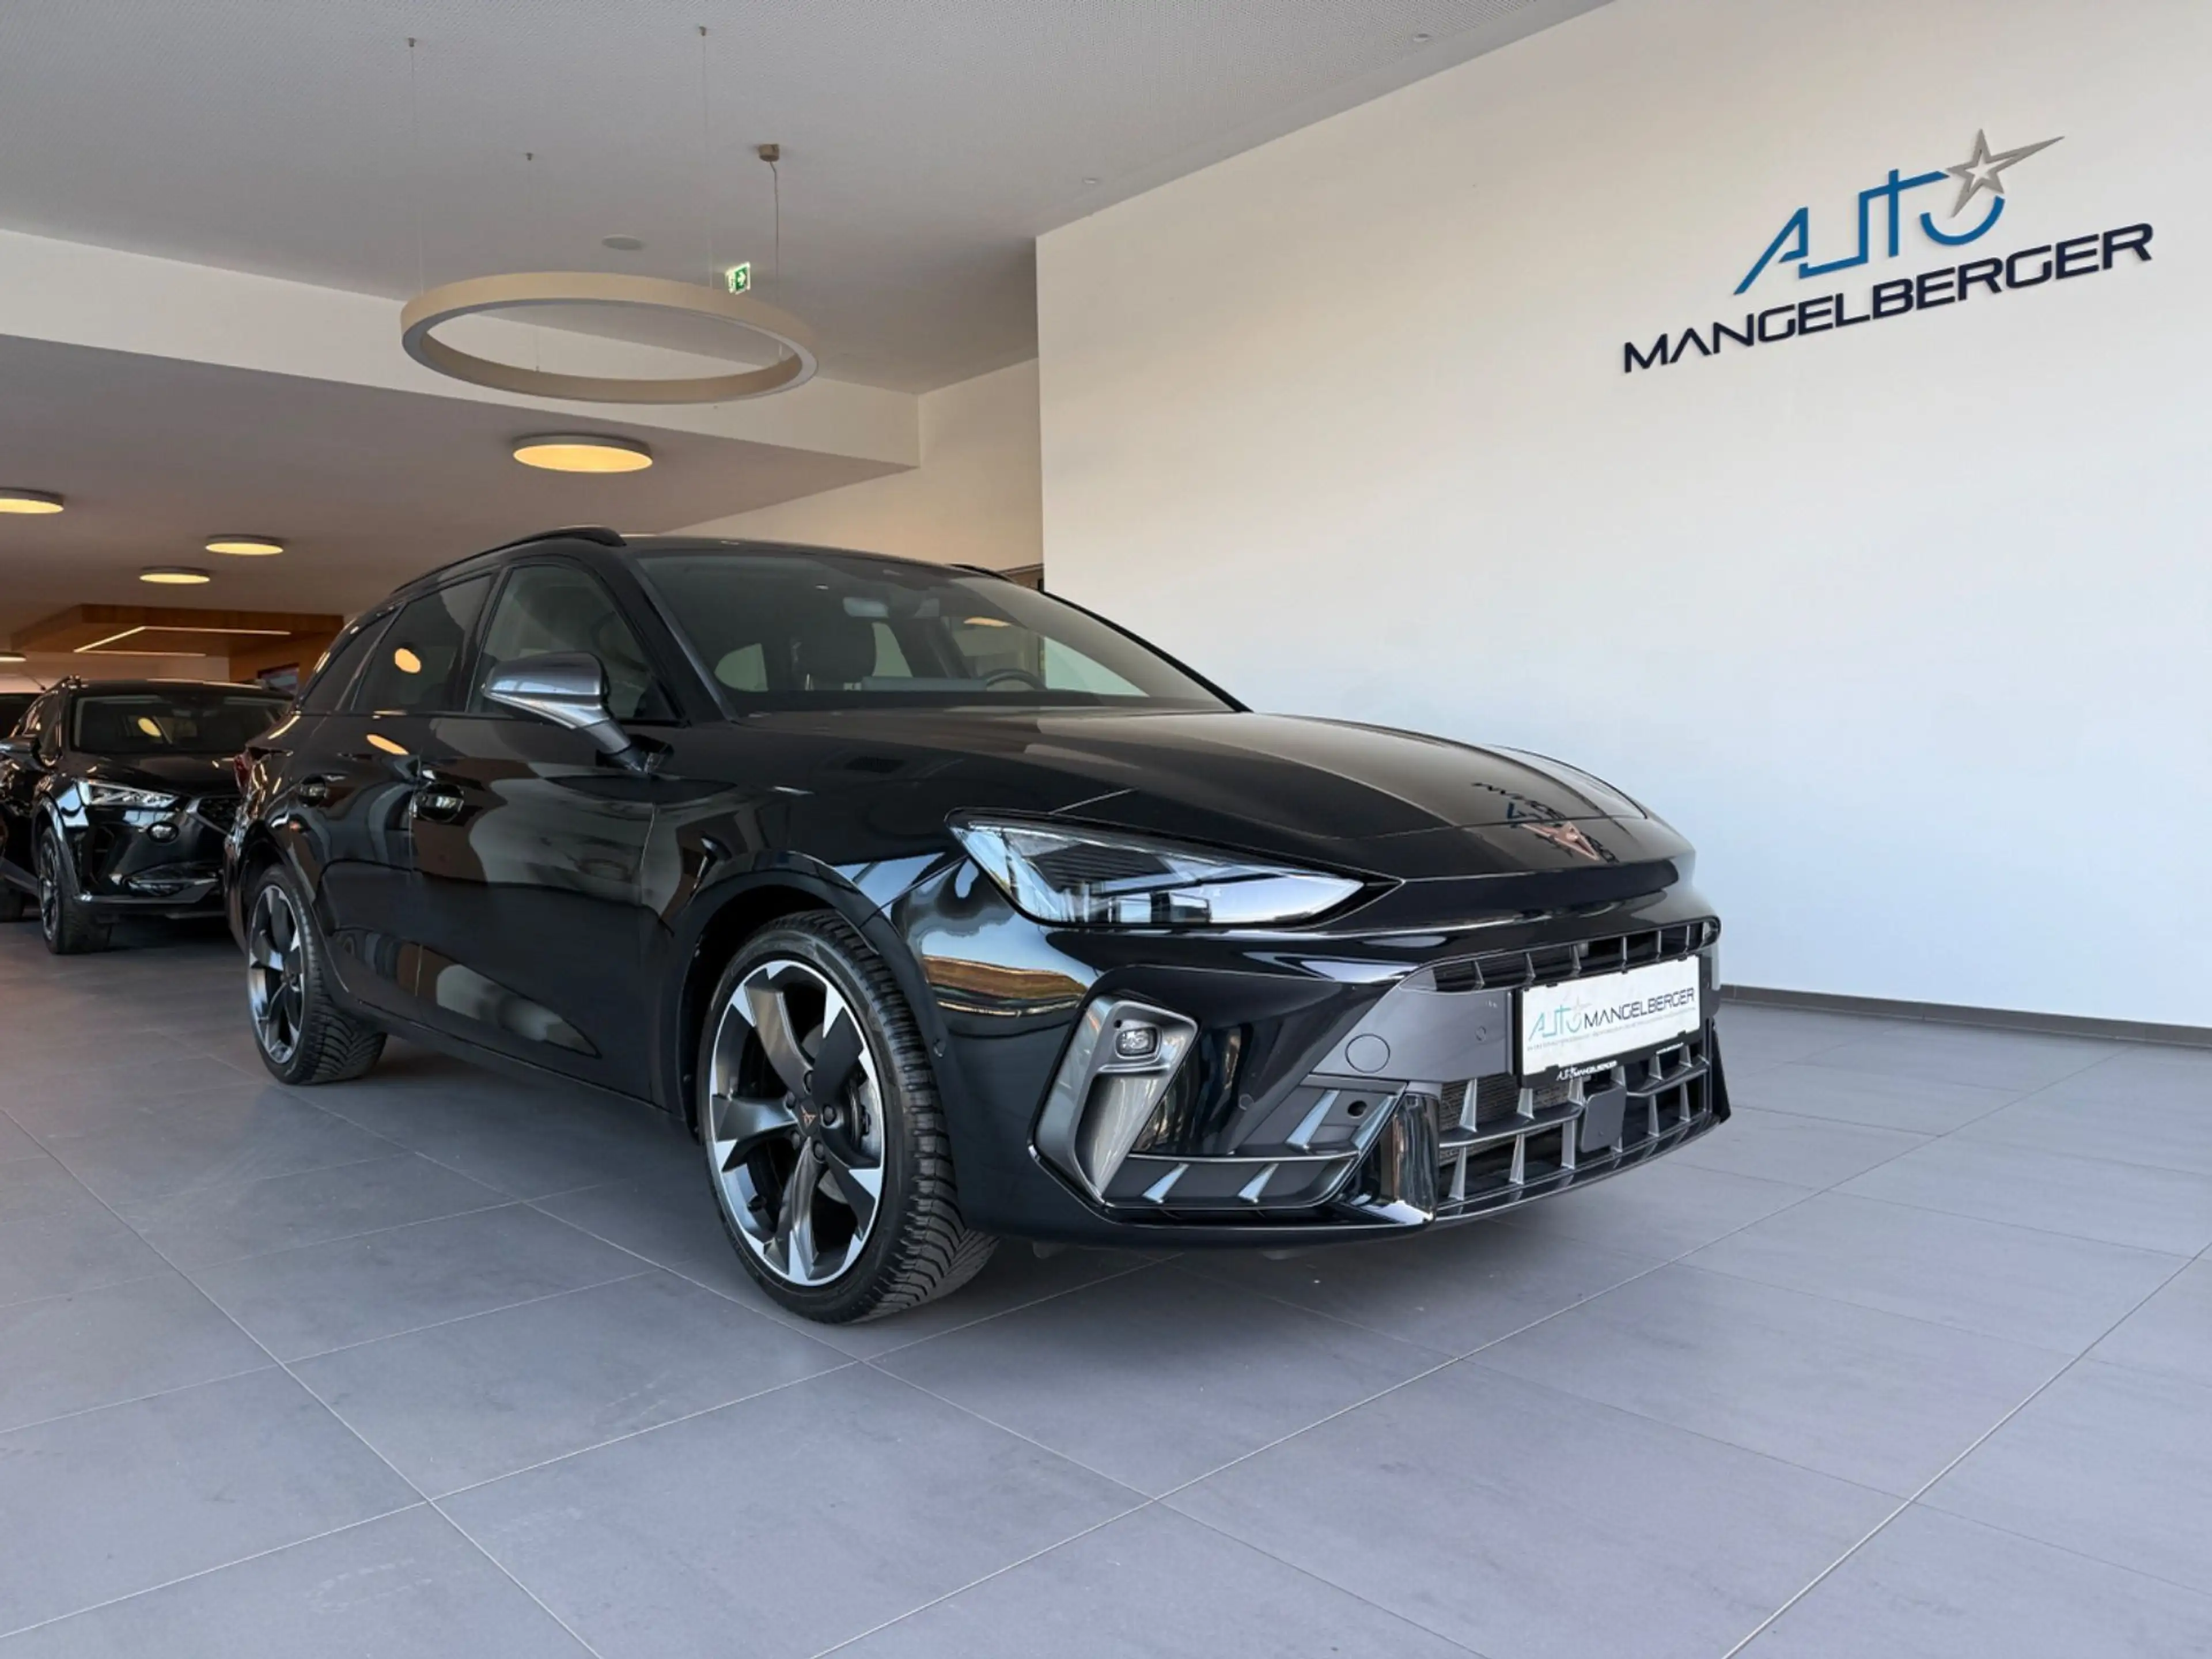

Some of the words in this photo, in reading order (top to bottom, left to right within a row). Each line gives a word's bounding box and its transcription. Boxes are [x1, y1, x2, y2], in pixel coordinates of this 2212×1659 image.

[1734, 168, 2006, 296] AUTO
[1623, 222, 2154, 374] MANGELBERGER
[1584, 987, 1695, 1029] MANGELBERGER
